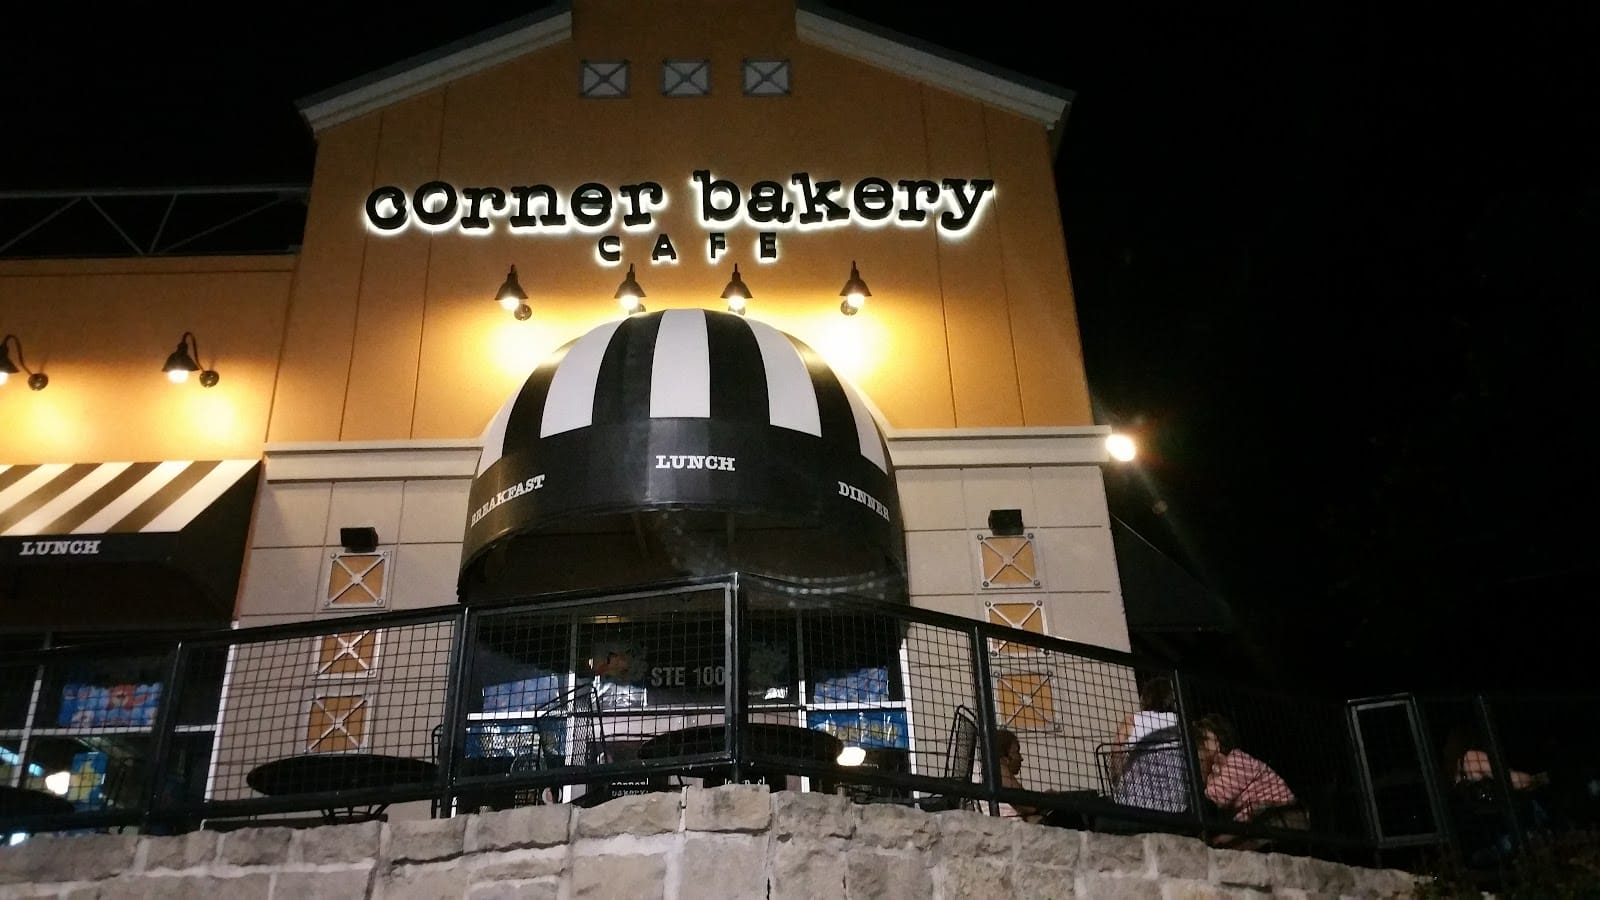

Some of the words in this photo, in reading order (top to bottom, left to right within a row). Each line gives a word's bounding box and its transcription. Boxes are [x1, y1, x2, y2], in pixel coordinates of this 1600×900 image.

[365, 180, 664, 230] corner
[693, 169, 994, 231] bakery
[598, 232, 777, 262] CAFE
[655, 454, 736, 471] LUNCH
[470, 474, 546, 528] BREAKFAST
[838, 481, 890, 522] DINNER
[19, 540, 102, 556] LUNCH
[651, 666, 685, 687] STE
[693, 666, 726, 686] 100
